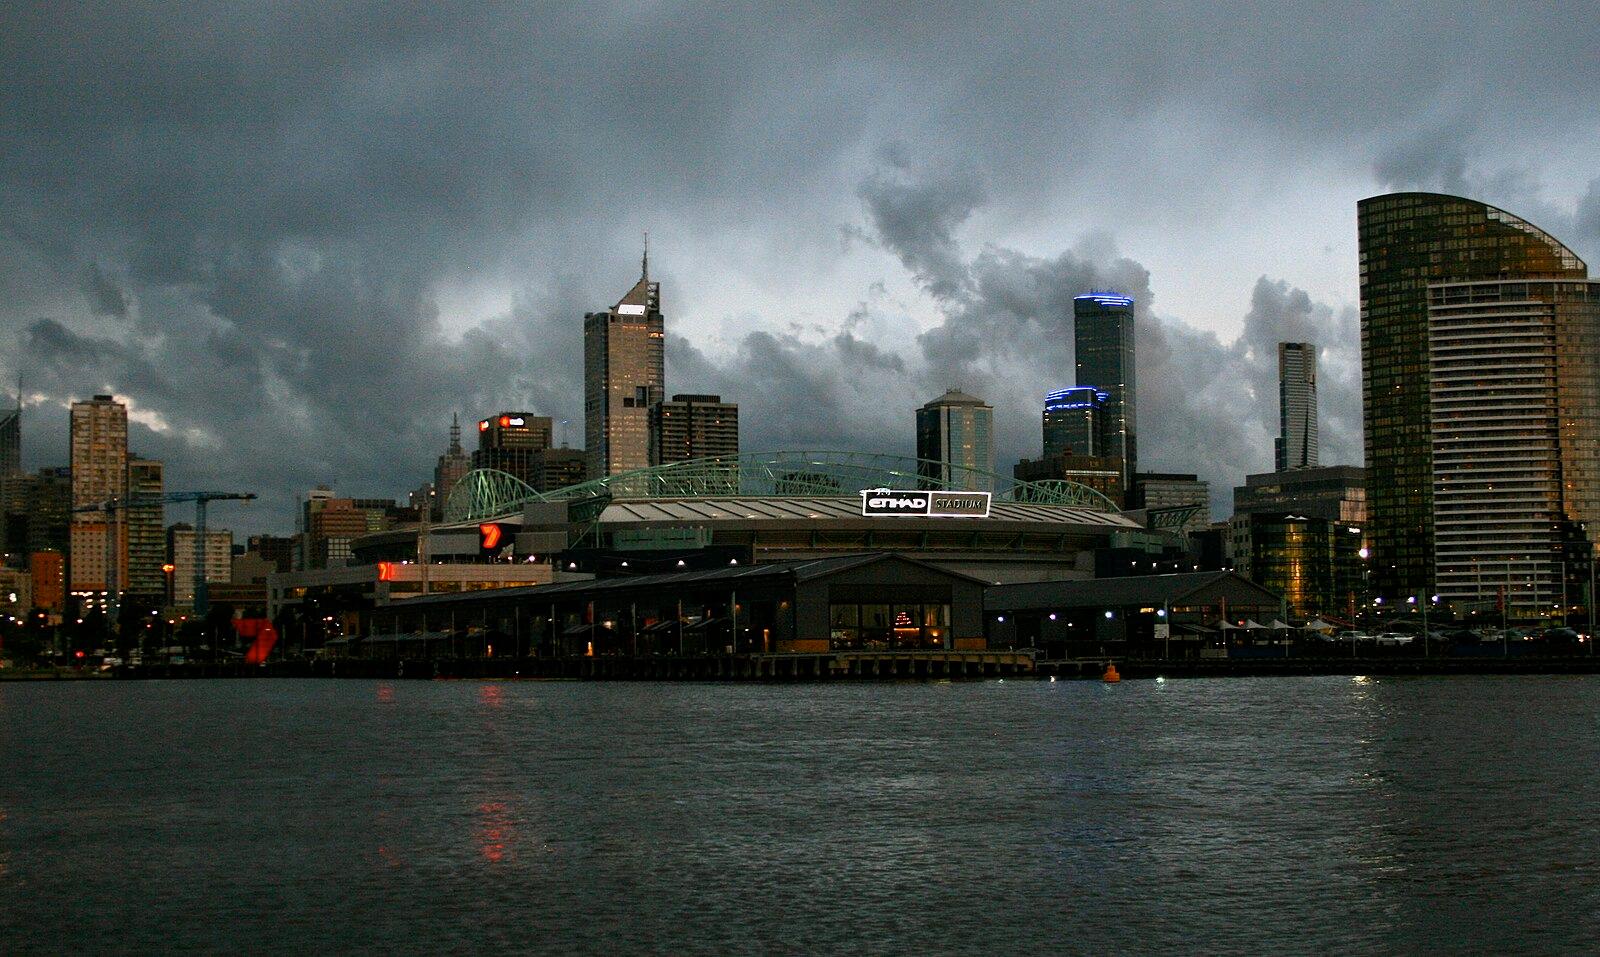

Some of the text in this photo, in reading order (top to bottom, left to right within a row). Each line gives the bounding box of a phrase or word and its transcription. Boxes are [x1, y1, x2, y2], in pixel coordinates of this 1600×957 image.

[935, 498, 982, 509] STADIUM
[479, 523, 502, 549] 7
[232, 617, 278, 664] 7
